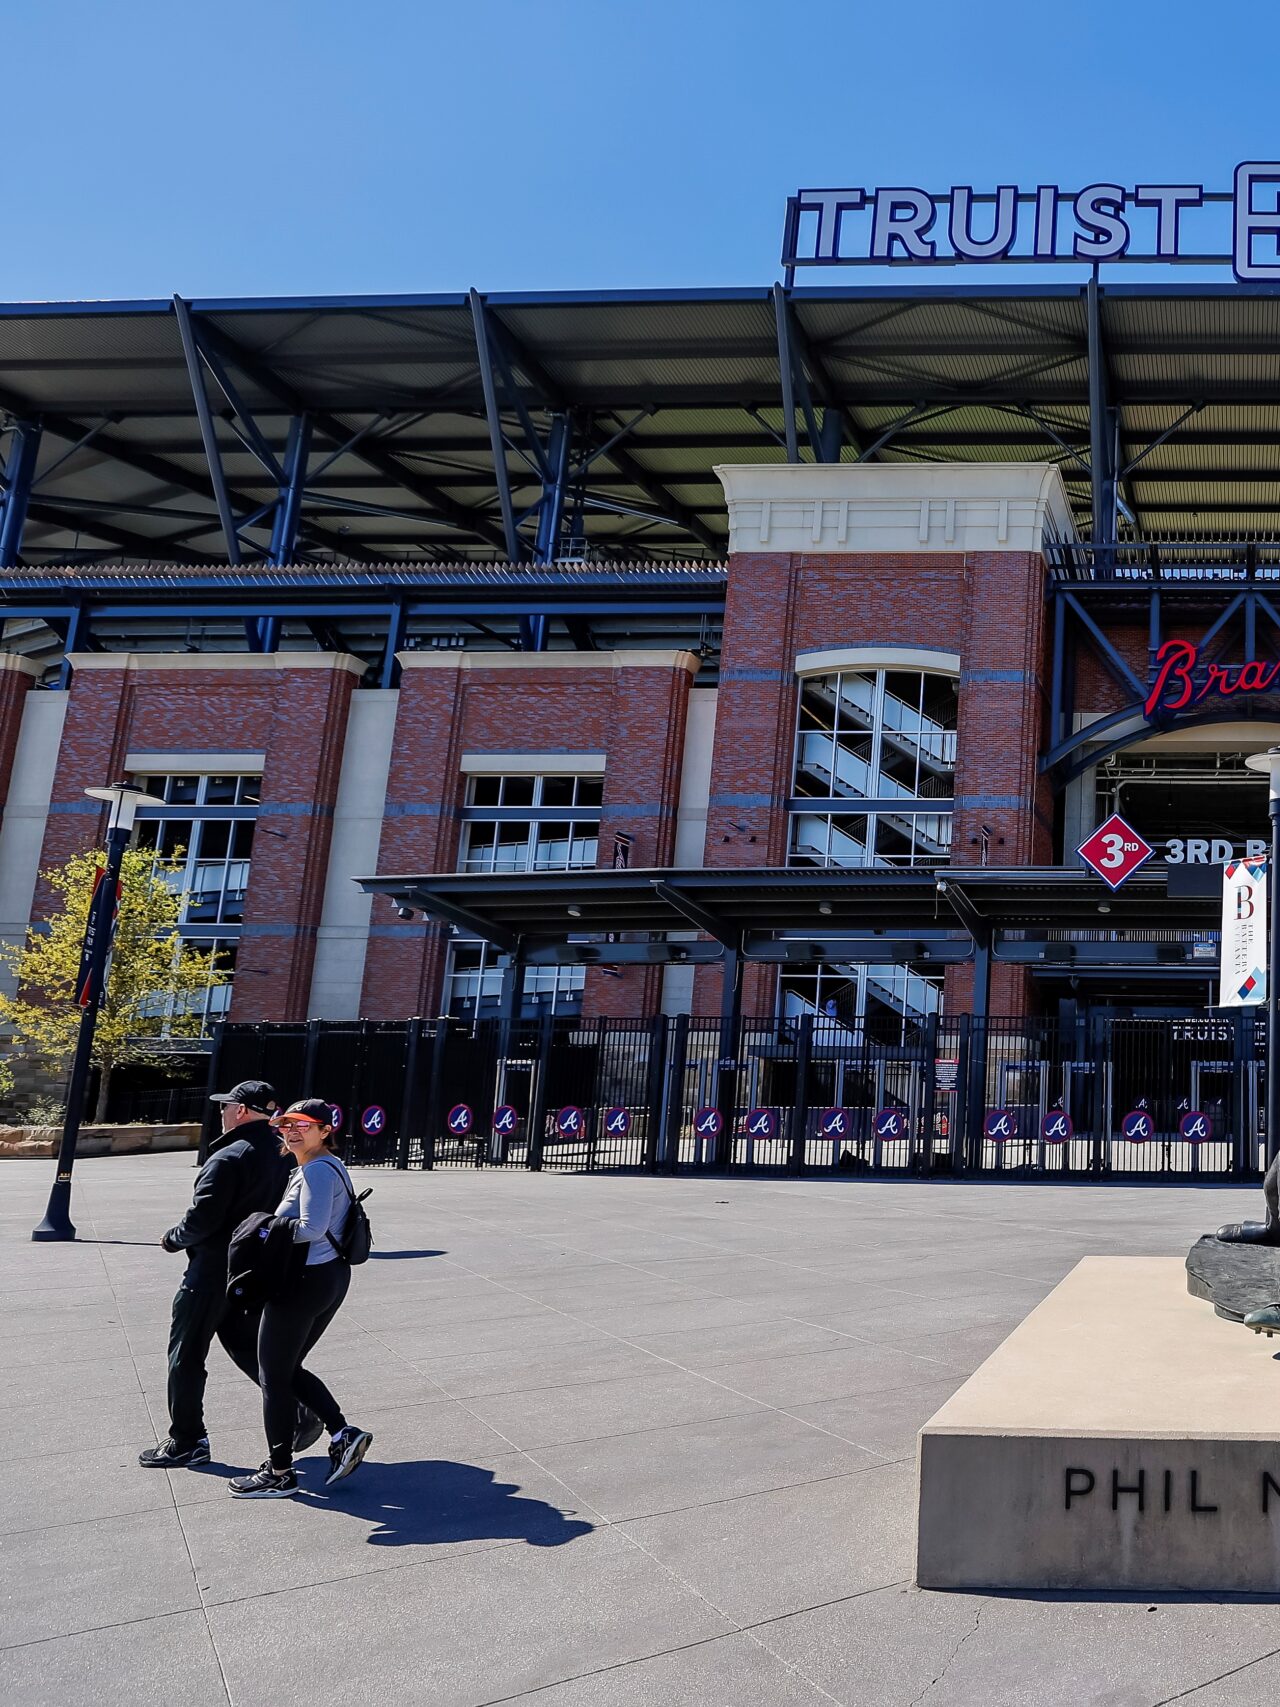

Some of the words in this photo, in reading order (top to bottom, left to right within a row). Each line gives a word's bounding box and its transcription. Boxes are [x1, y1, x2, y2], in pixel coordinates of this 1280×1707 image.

[797, 183, 1204, 263] TRUIST
[1099, 832, 1140, 869] 3RD
[1164, 838, 1234, 865] 3RD
[1233, 884, 1255, 921] B
[364, 1110, 382, 1129] A
[450, 1109, 468, 1128] A
[495, 1109, 513, 1129] A
[559, 1110, 578, 1130] A
[606, 1111, 626, 1132] A
[696, 1112, 717, 1132] A
[749, 1113, 770, 1134] A
[823, 1112, 845, 1133] A
[877, 1114, 898, 1135] A
[987, 1115, 1010, 1136] A
[1045, 1115, 1067, 1137] A
[1126, 1116, 1148, 1137] A
[1184, 1116, 1206, 1137] A
[1063, 1466, 1219, 1514] PHIL
